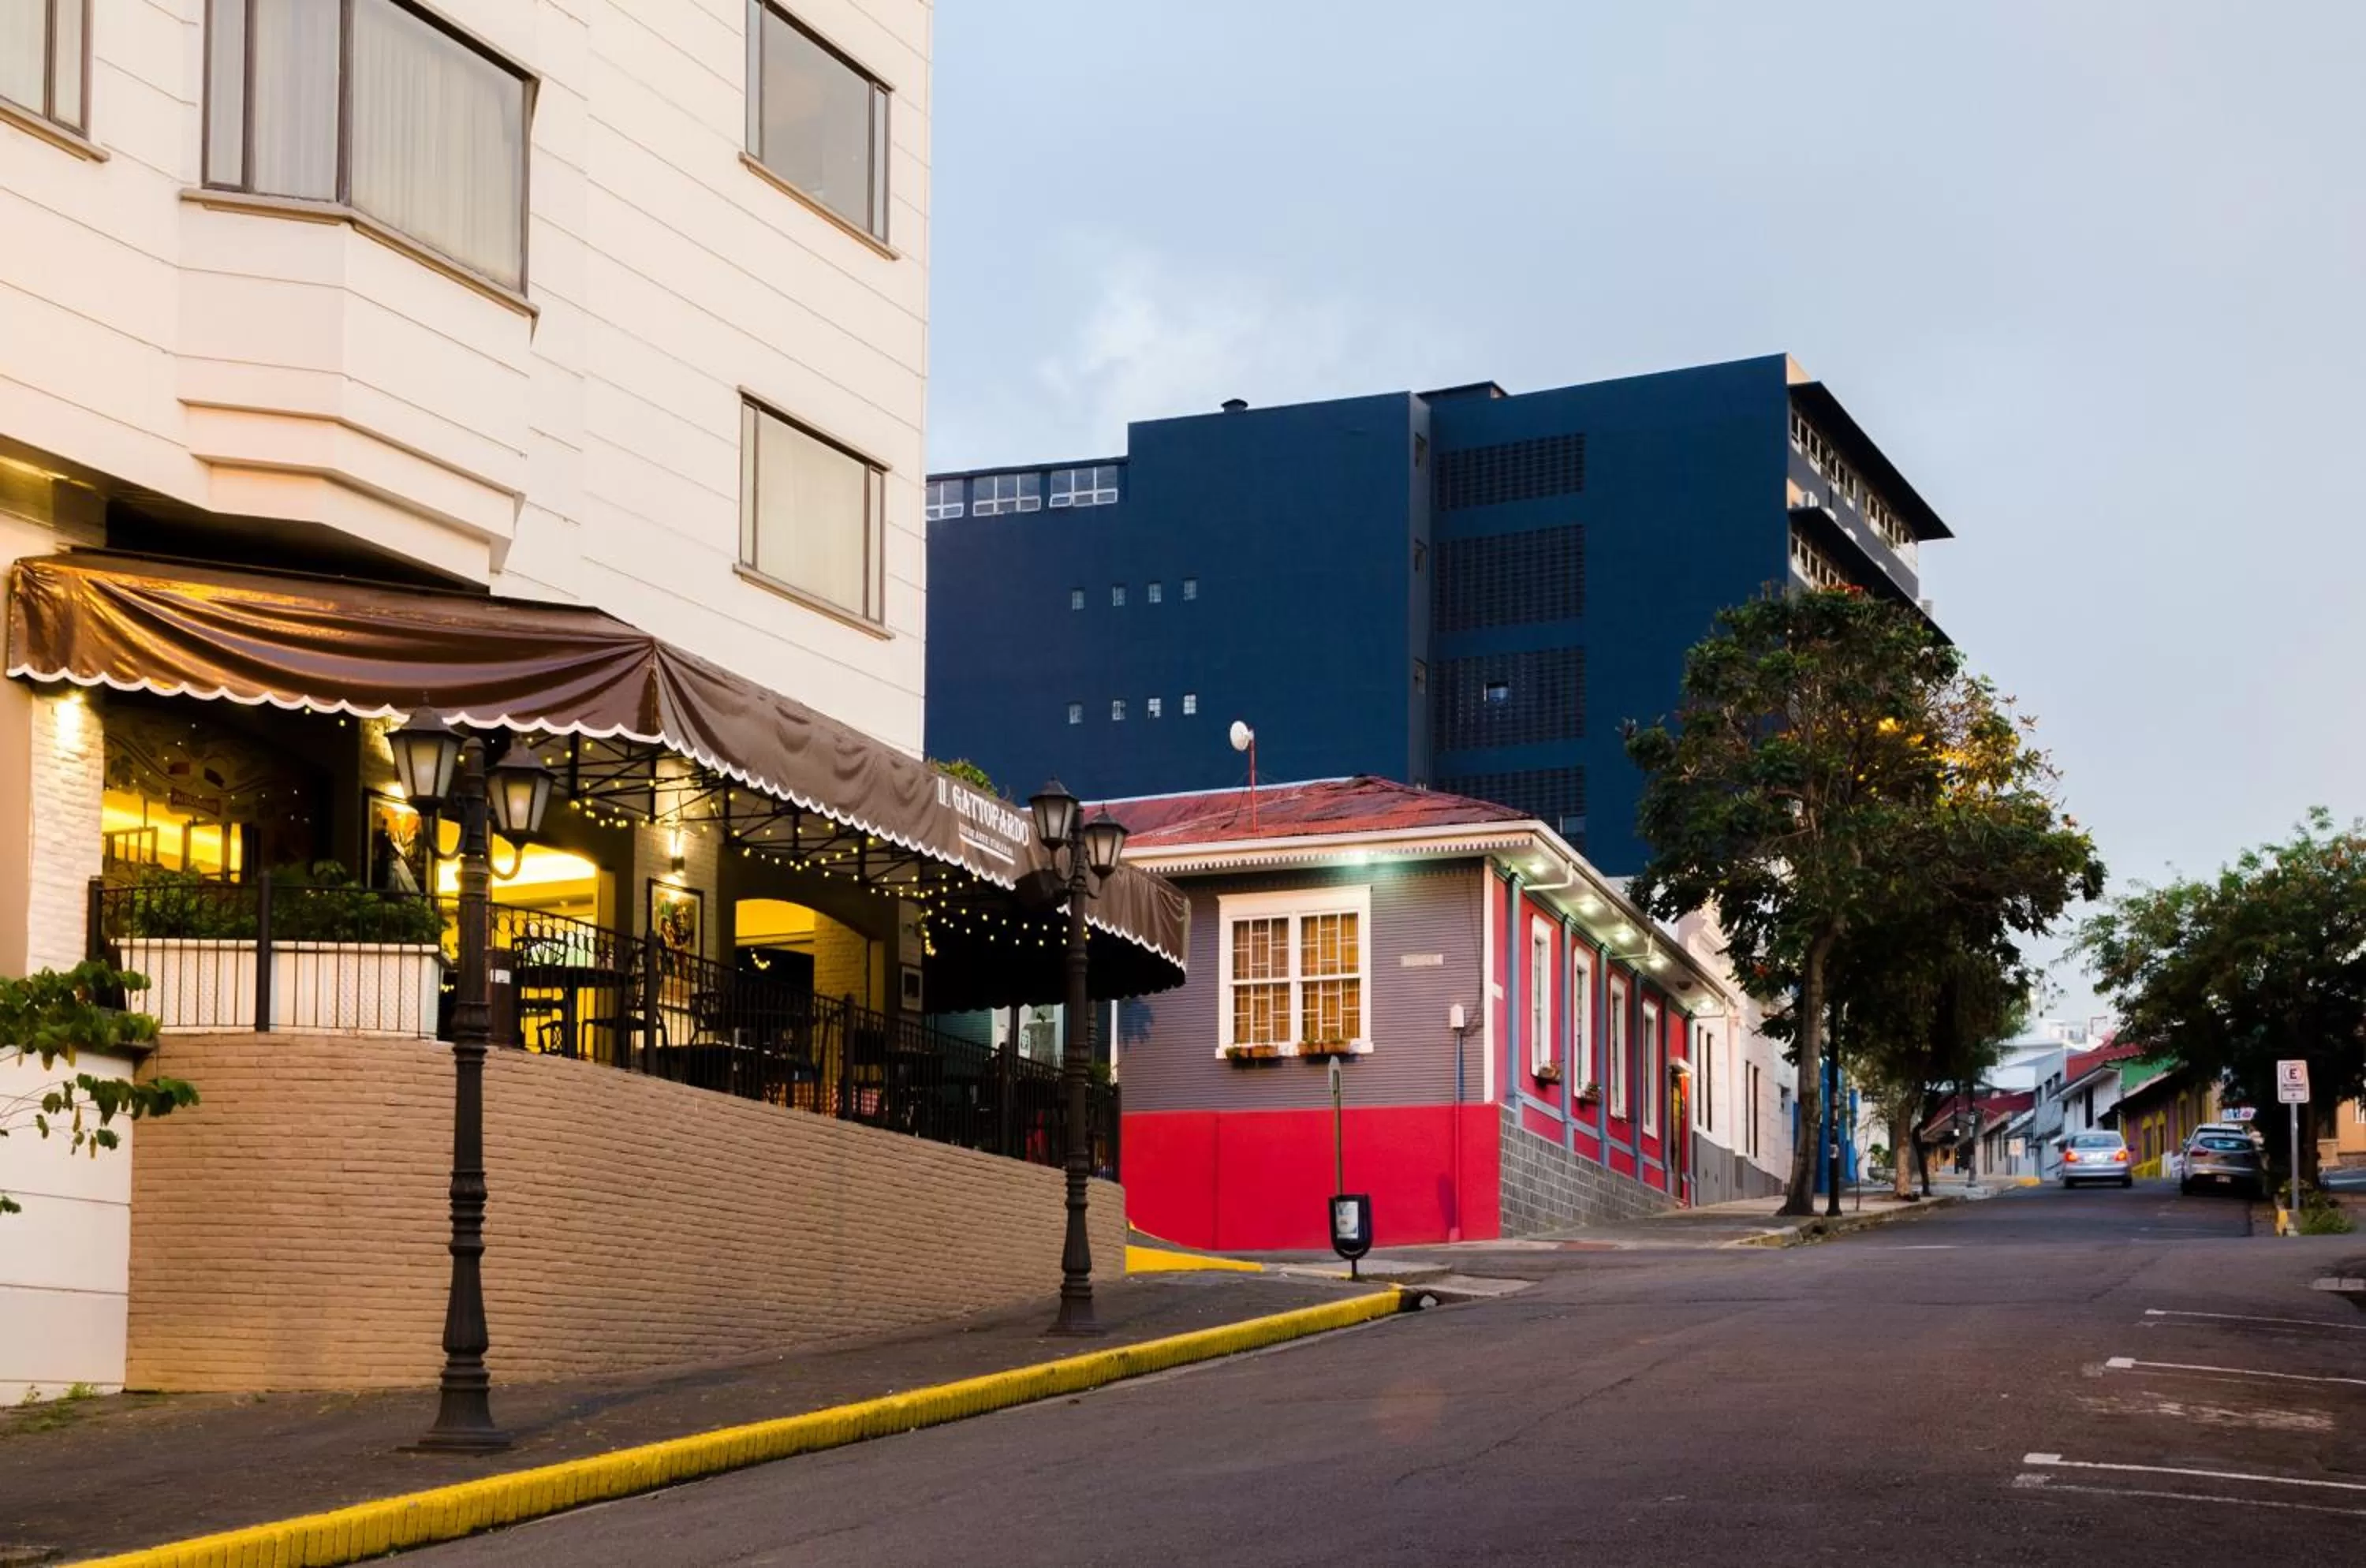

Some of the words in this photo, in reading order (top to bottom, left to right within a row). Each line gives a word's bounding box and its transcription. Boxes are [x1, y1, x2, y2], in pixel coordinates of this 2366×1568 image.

[938, 776, 951, 808] IL
[952, 784, 1029, 846] GATTOPARDO
[2289, 1068, 2297, 1080] E
